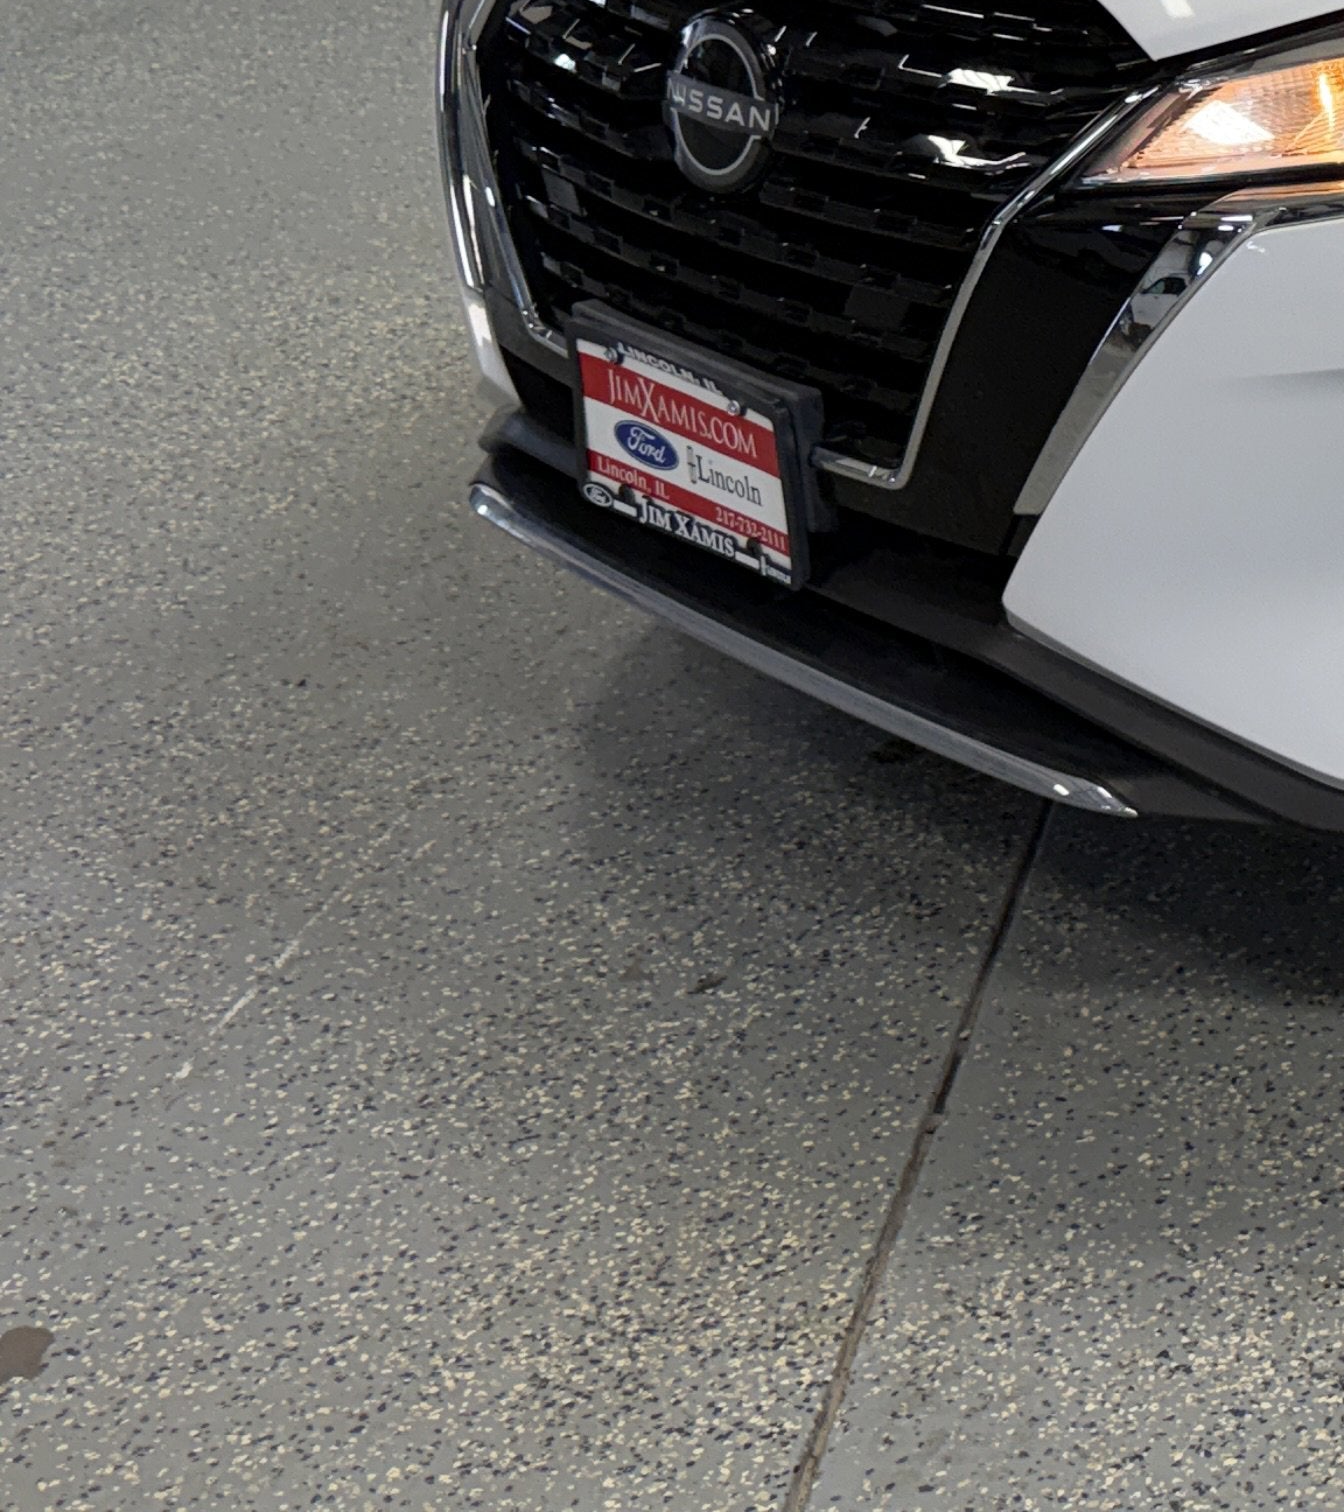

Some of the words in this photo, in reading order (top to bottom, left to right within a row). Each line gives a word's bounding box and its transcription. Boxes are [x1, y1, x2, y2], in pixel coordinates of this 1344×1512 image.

[666, 77, 771, 132] NISSAN
[608, 369, 757, 459] JIMXAMIS.COM
[627, 426, 667, 464] Ford
[597, 455, 651, 493] Lincoln,
[655, 480, 671, 500] IL
[696, 454, 763, 507] Lincoln
[640, 498, 673, 533] JIM
[671, 513, 736, 558] XAMIS
